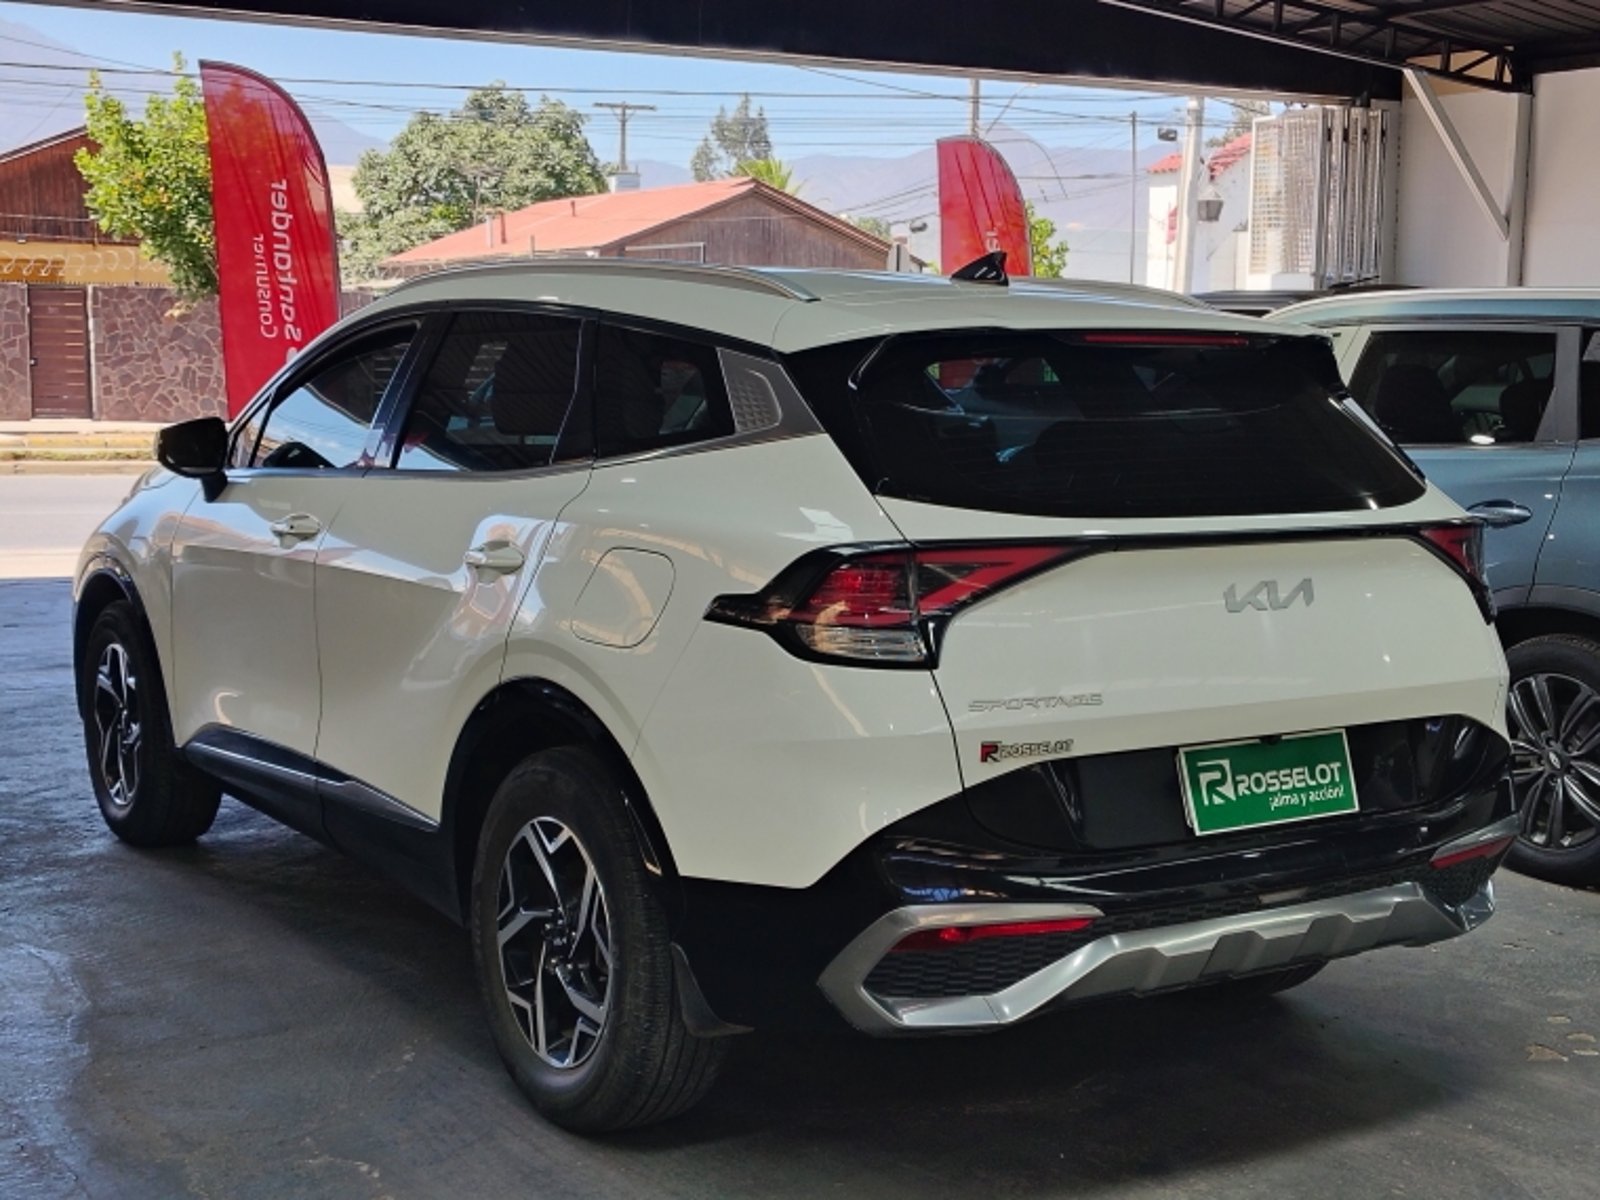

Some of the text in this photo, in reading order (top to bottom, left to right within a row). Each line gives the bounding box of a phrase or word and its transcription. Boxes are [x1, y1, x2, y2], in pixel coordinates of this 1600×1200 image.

[1223, 578, 1314, 613] KIA
[968, 693, 1104, 713] SPORTAGE
[1235, 762, 1342, 796] ROSSELOT
[1300, 793, 1309, 807] y
